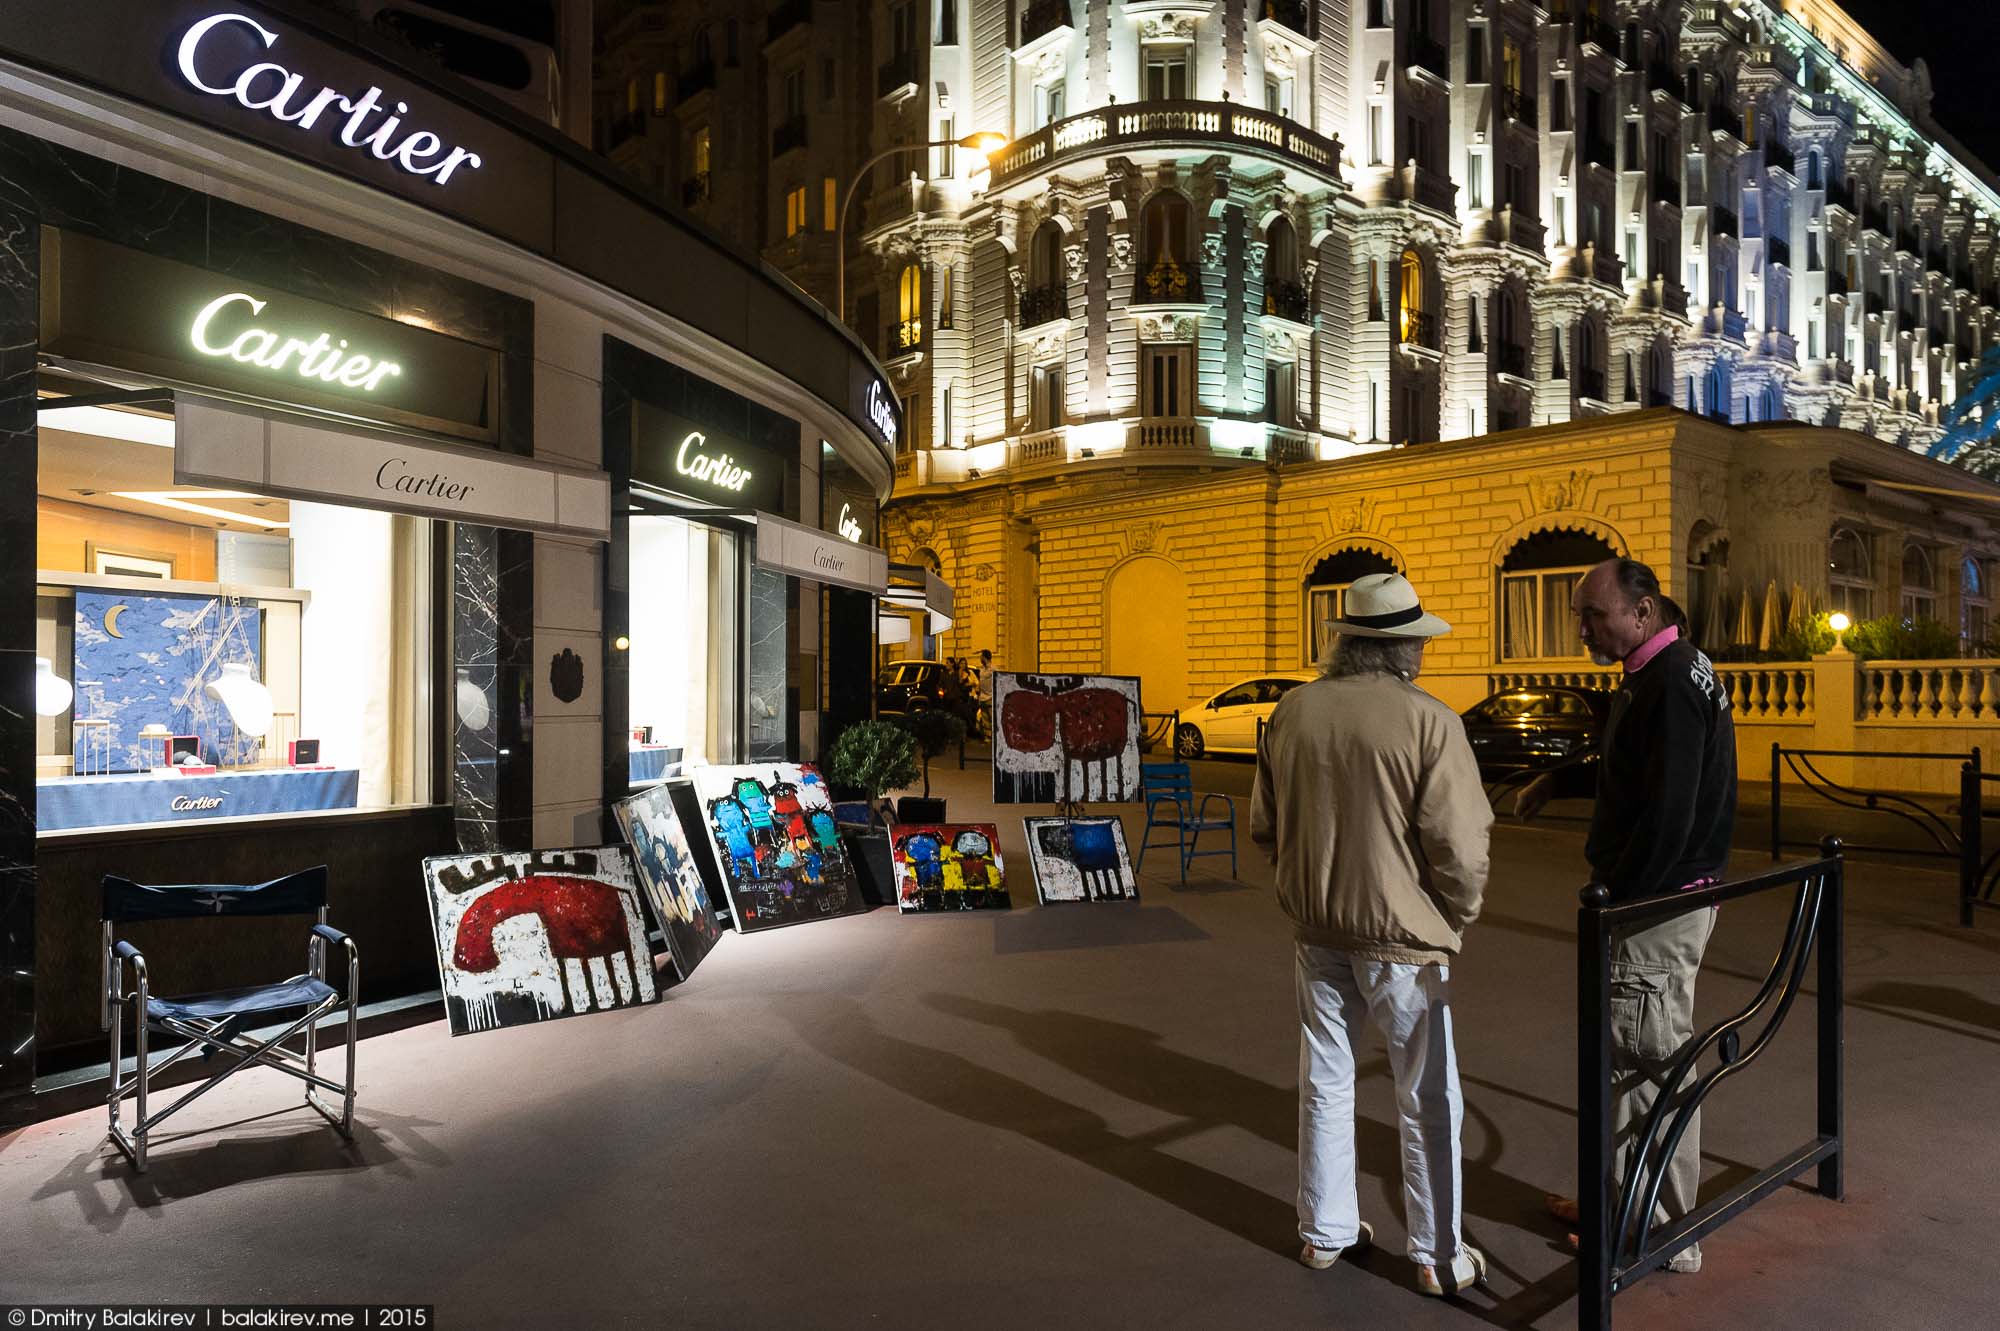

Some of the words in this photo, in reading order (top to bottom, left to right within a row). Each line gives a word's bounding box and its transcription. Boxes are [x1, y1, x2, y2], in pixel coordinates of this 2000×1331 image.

[177, 13, 482, 186] Cartier
[189, 292, 403, 392] Cartier
[870, 380, 896, 444] Cartier
[376, 458, 474, 501] Cartier
[676, 431, 752, 492] Cartier
[813, 546, 845, 571] Cartier
[171, 795, 224, 811] Cartier
